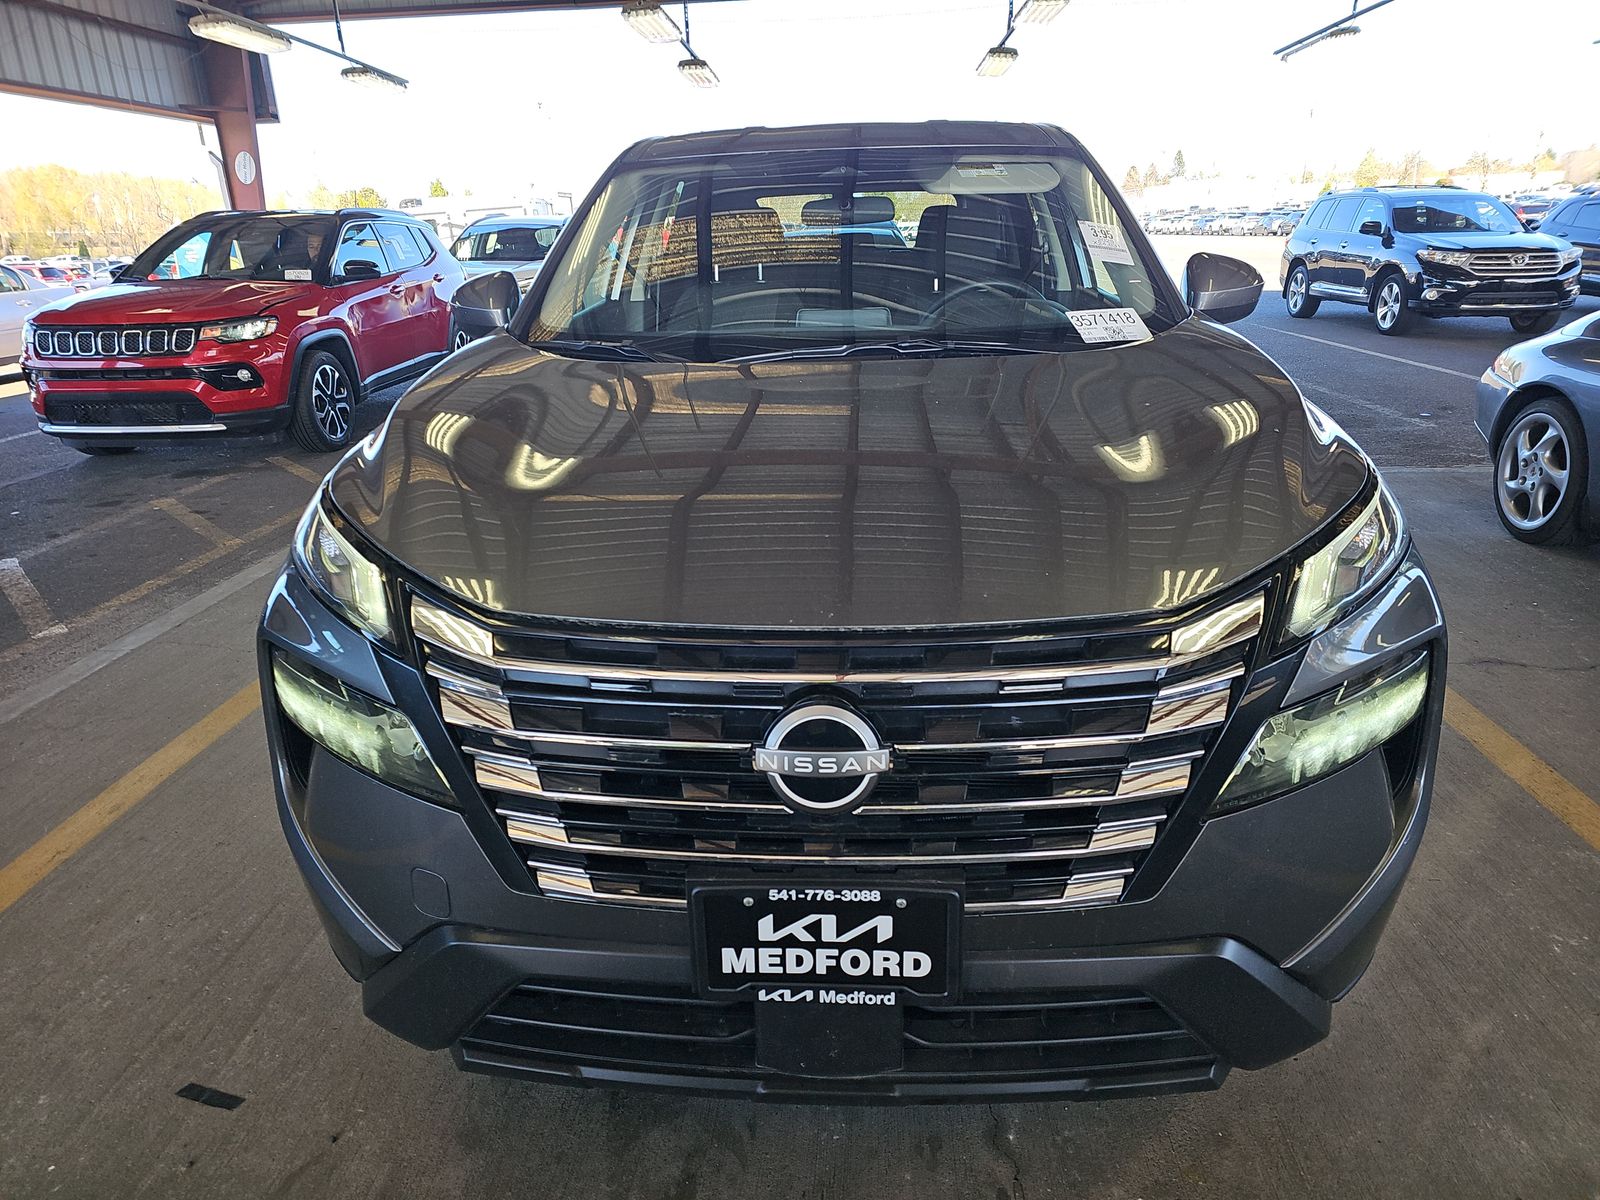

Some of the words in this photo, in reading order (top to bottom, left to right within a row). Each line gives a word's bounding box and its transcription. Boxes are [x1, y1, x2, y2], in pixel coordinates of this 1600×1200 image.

[1071, 312, 1136, 327] 3571418
[759, 753, 885, 774] NISSAN
[768, 889, 881, 902] 541-776-3088
[757, 913, 893, 944] KIA
[721, 947, 932, 978] MEDFORD
[758, 988, 814, 1002] KIA
[819, 990, 896, 1006] Medford
